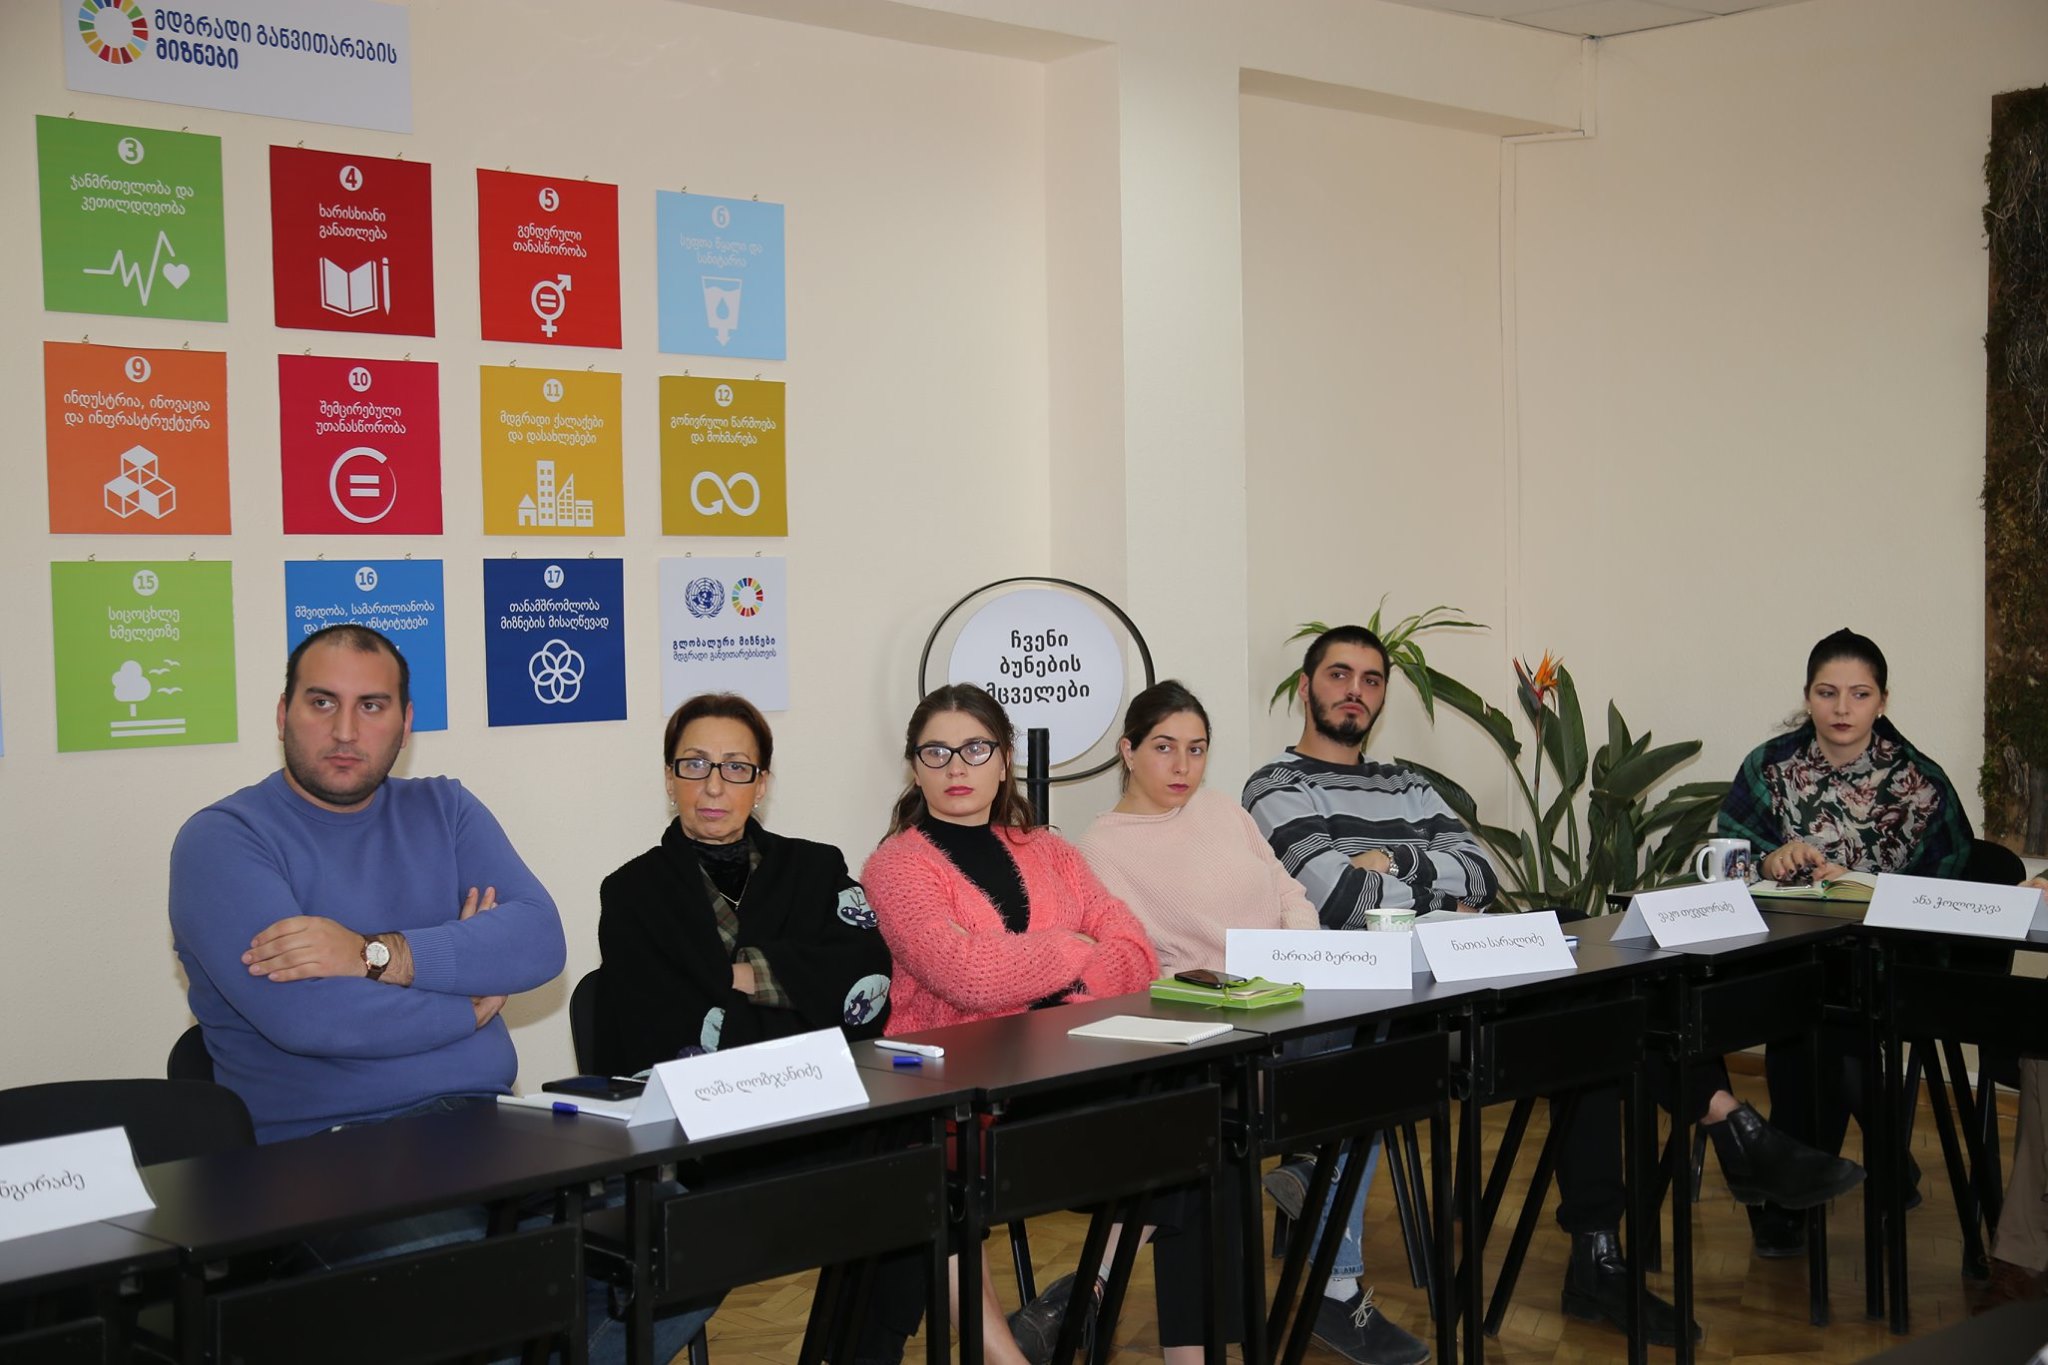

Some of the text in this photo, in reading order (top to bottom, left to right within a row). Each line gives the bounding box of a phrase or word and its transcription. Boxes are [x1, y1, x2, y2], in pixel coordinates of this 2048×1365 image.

[154, 9, 398, 64] მდგრადი განვითარების
[155, 37, 239, 70] მიზნები
[124, 141, 139, 161] 3
[69, 173, 194, 199] ჯანმრთელობა და
[345, 168, 358, 189] 4
[81, 195, 186, 217] კეთილდღეობა
[544, 189, 554, 209] 5
[318, 203, 386, 222] ხარისხიანი
[717, 207, 726, 226] 6
[319, 222, 388, 242] განათლება
[517, 224, 582, 242] გენდერული
[513, 239, 587, 258] თანასწორობა
[132, 358, 145, 380] 9
[352, 372, 369, 387] 10
[545, 383, 561, 397] 11
[717, 389, 731, 402] 12
[63, 389, 210, 414] ინდუსტრია, ინოვაცია
[319, 400, 402, 418] შემცირებული
[64, 410, 210, 433] და ინფრასტრუქტურა
[315, 418, 406, 435] უთანასწორობა
[500, 409, 604, 430] მდგრადი ქალაქები
[508, 428, 597, 446] და დასახლებები
[690, 433, 704, 445] და
[137, 575, 155, 591] 15
[358, 572, 374, 586] 16
[547, 570, 561, 583] 17
[108, 606, 180, 624] სიცოცხლე
[294, 600, 435, 619] მშვიდობა, სამართლიანობა
[509, 598, 600, 614] თანამშრომლობა
[303, 623, 318, 635] და
[365, 615, 429, 631] ინსტიტუტები
[500, 613, 609, 631] მიზნების მისაღწევად
[109, 623, 180, 641] ხმელეთზე
[1011, 629, 1069, 653] ჩვენი
[672, 635, 776, 650] გლობალური მიზნები
[999, 653, 1081, 679] ბუნების
[986, 679, 1090, 705] მცველები
[1912, 894, 2001, 915] ანა ჭოლოკავა
[1450, 932, 1545, 951] ნათია სარალიძე
[1272, 949, 1377, 966] მარიამ ბერიძე
[694, 1080, 734, 1101] ლაშა
